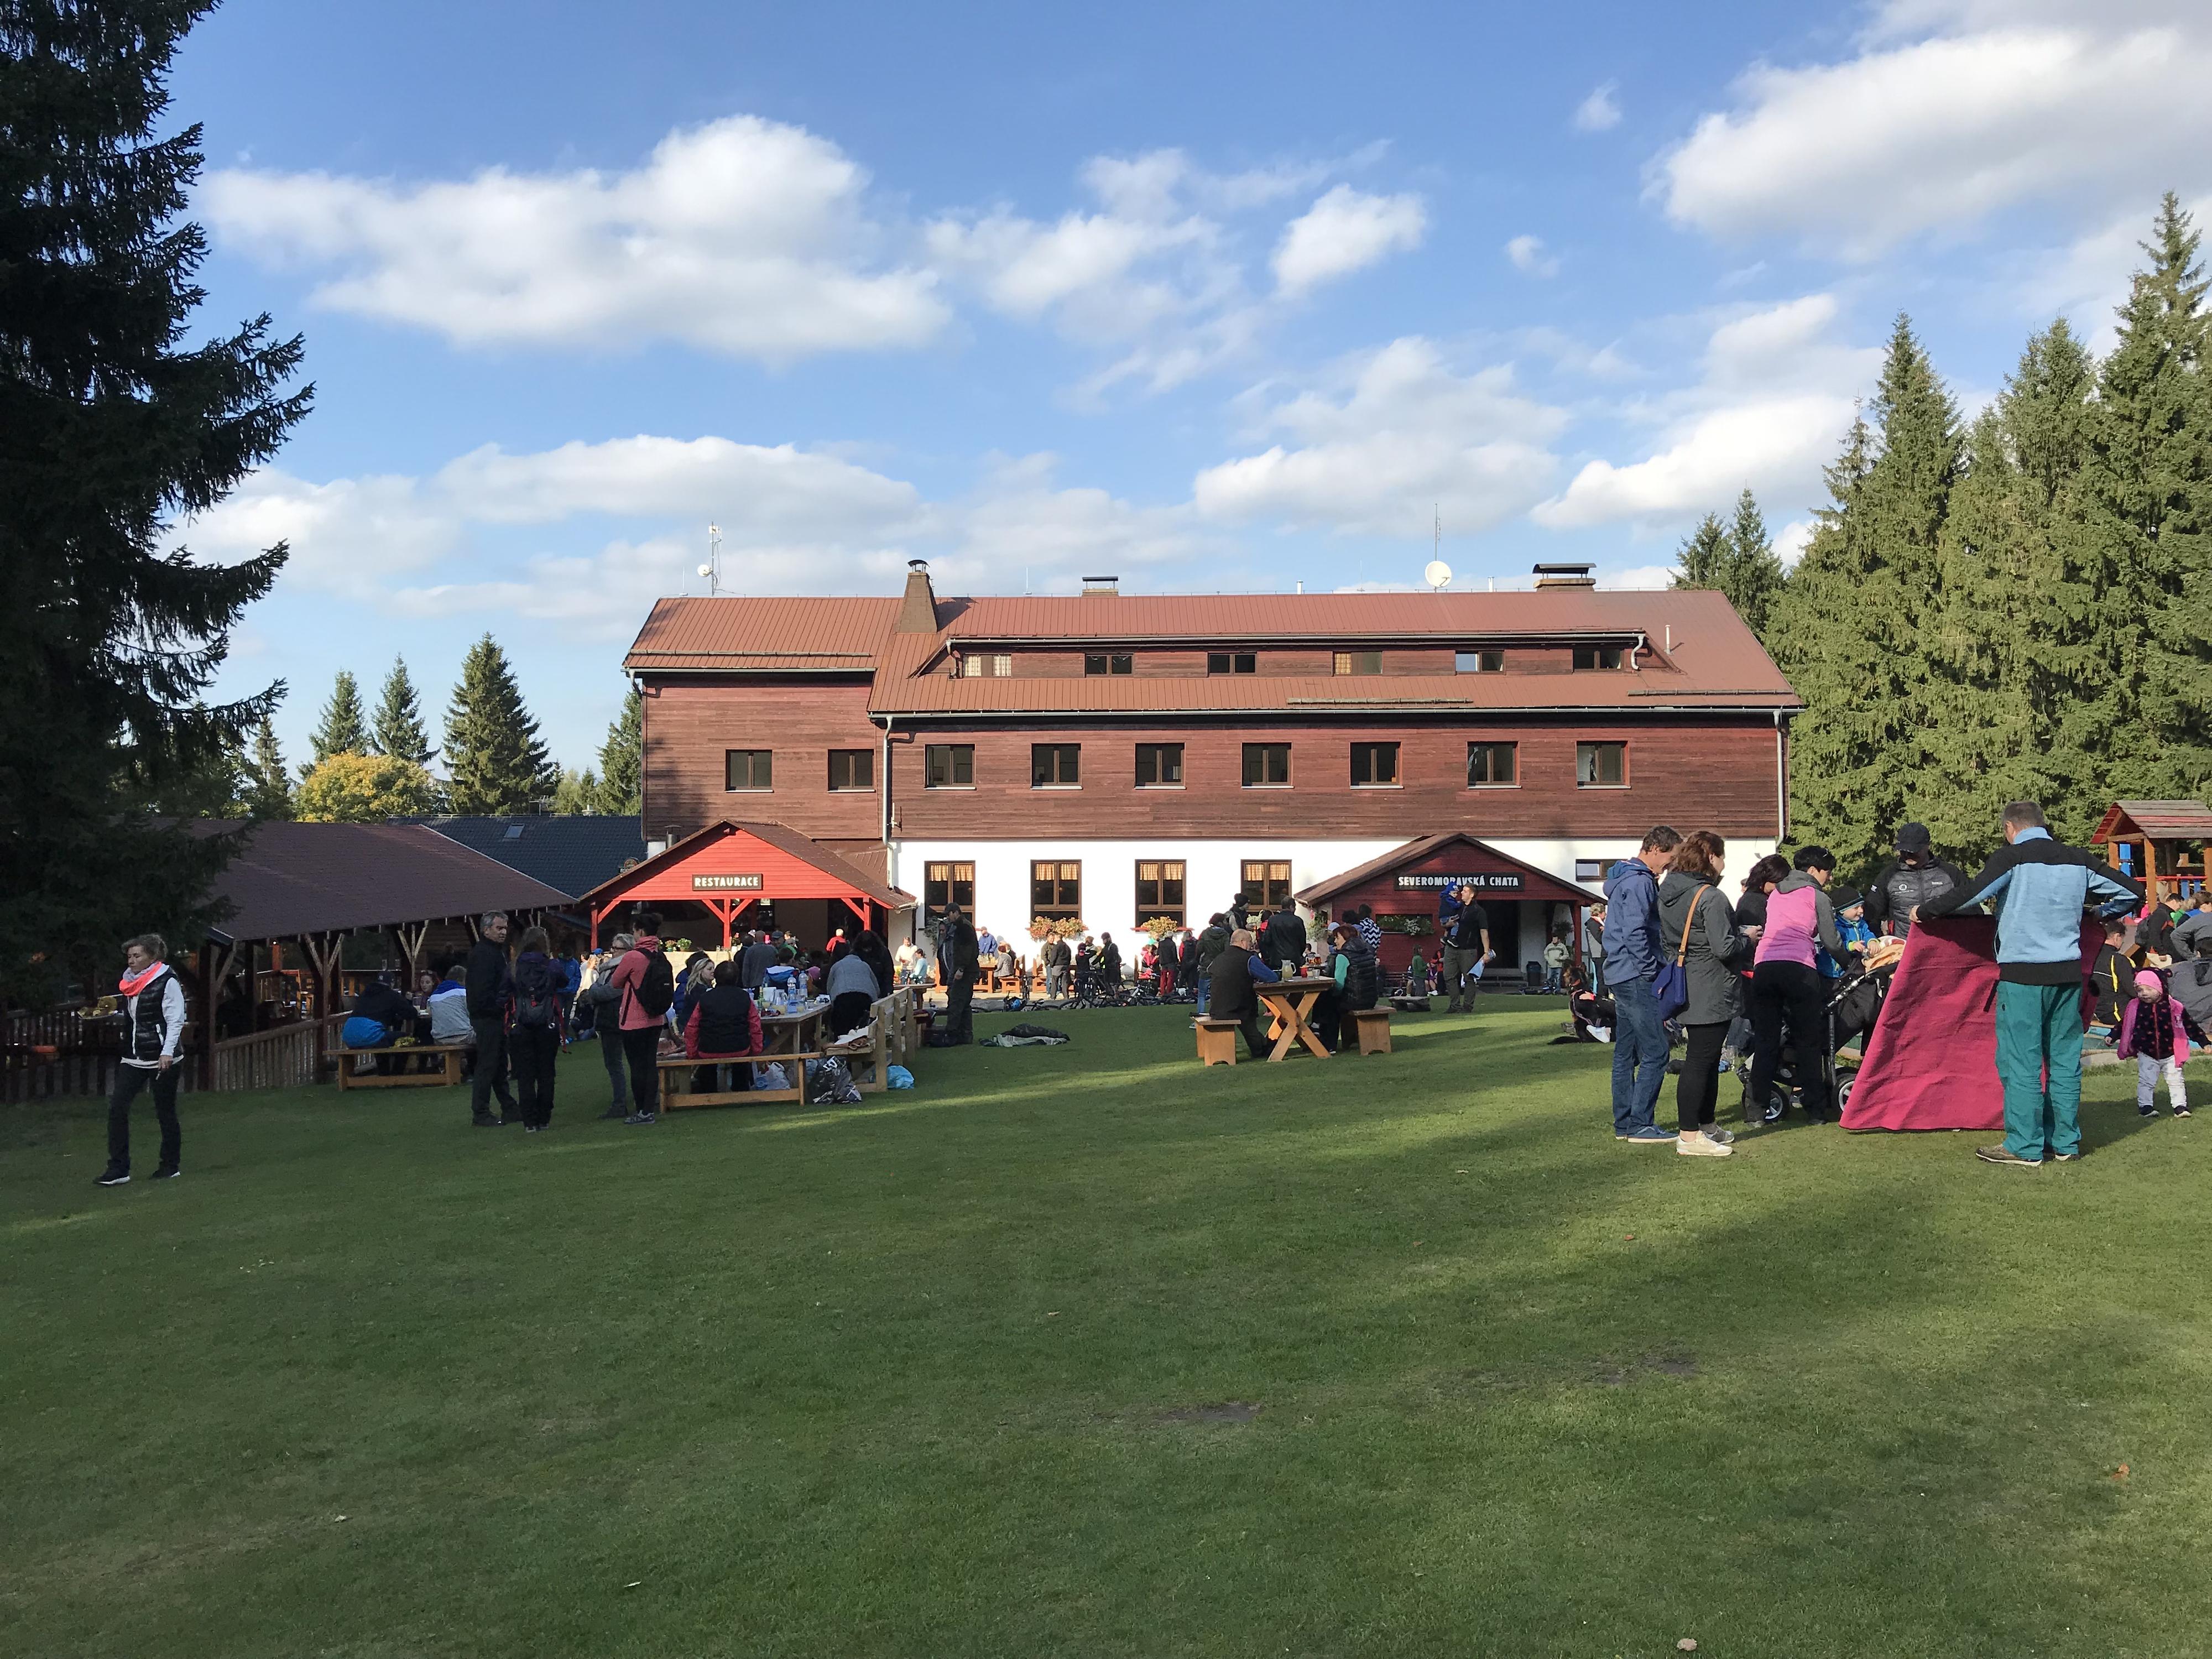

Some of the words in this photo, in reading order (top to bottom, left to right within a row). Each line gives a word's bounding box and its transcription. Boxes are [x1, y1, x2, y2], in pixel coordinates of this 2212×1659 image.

[695, 877, 758, 887] RESTAURACE
[1398, 875, 1485, 886] SEVEROMORAVSKÁ
[1490, 877, 1519, 886] CHATA
